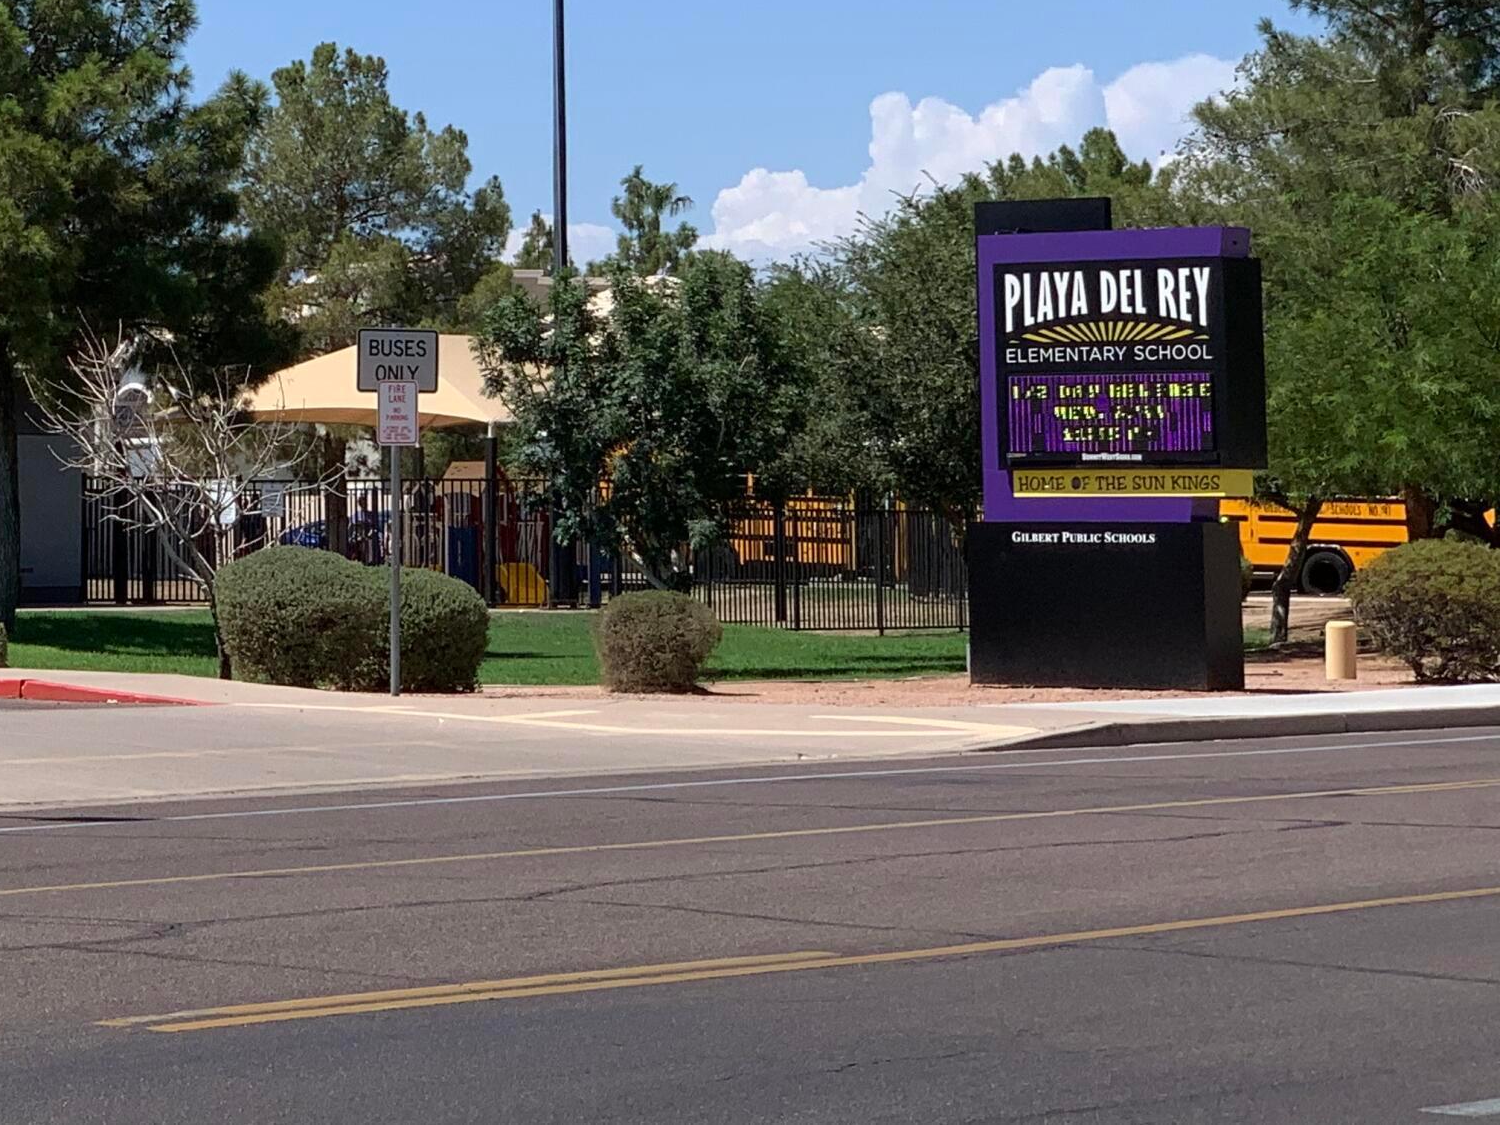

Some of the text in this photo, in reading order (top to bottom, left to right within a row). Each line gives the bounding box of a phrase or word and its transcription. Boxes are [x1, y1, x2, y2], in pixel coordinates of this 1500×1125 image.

[1004, 266, 1211, 333] PLAYA DEL REY
[368, 339, 427, 357] BUSES
[1005, 344, 1213, 364] ELEMENTARY SCHOOL
[375, 364, 419, 381] ONLY
[388, 384, 405, 394] FIRE
[388, 395, 406, 404] LANE
[1018, 475, 1066, 492] HOME
[1095, 475, 1127, 491] THE
[1132, 475, 1165, 490] SUN
[1171, 475, 1221, 491] KINGS
[1011, 531, 1156, 543] GILBERT PUBLIC SCHOOLS
